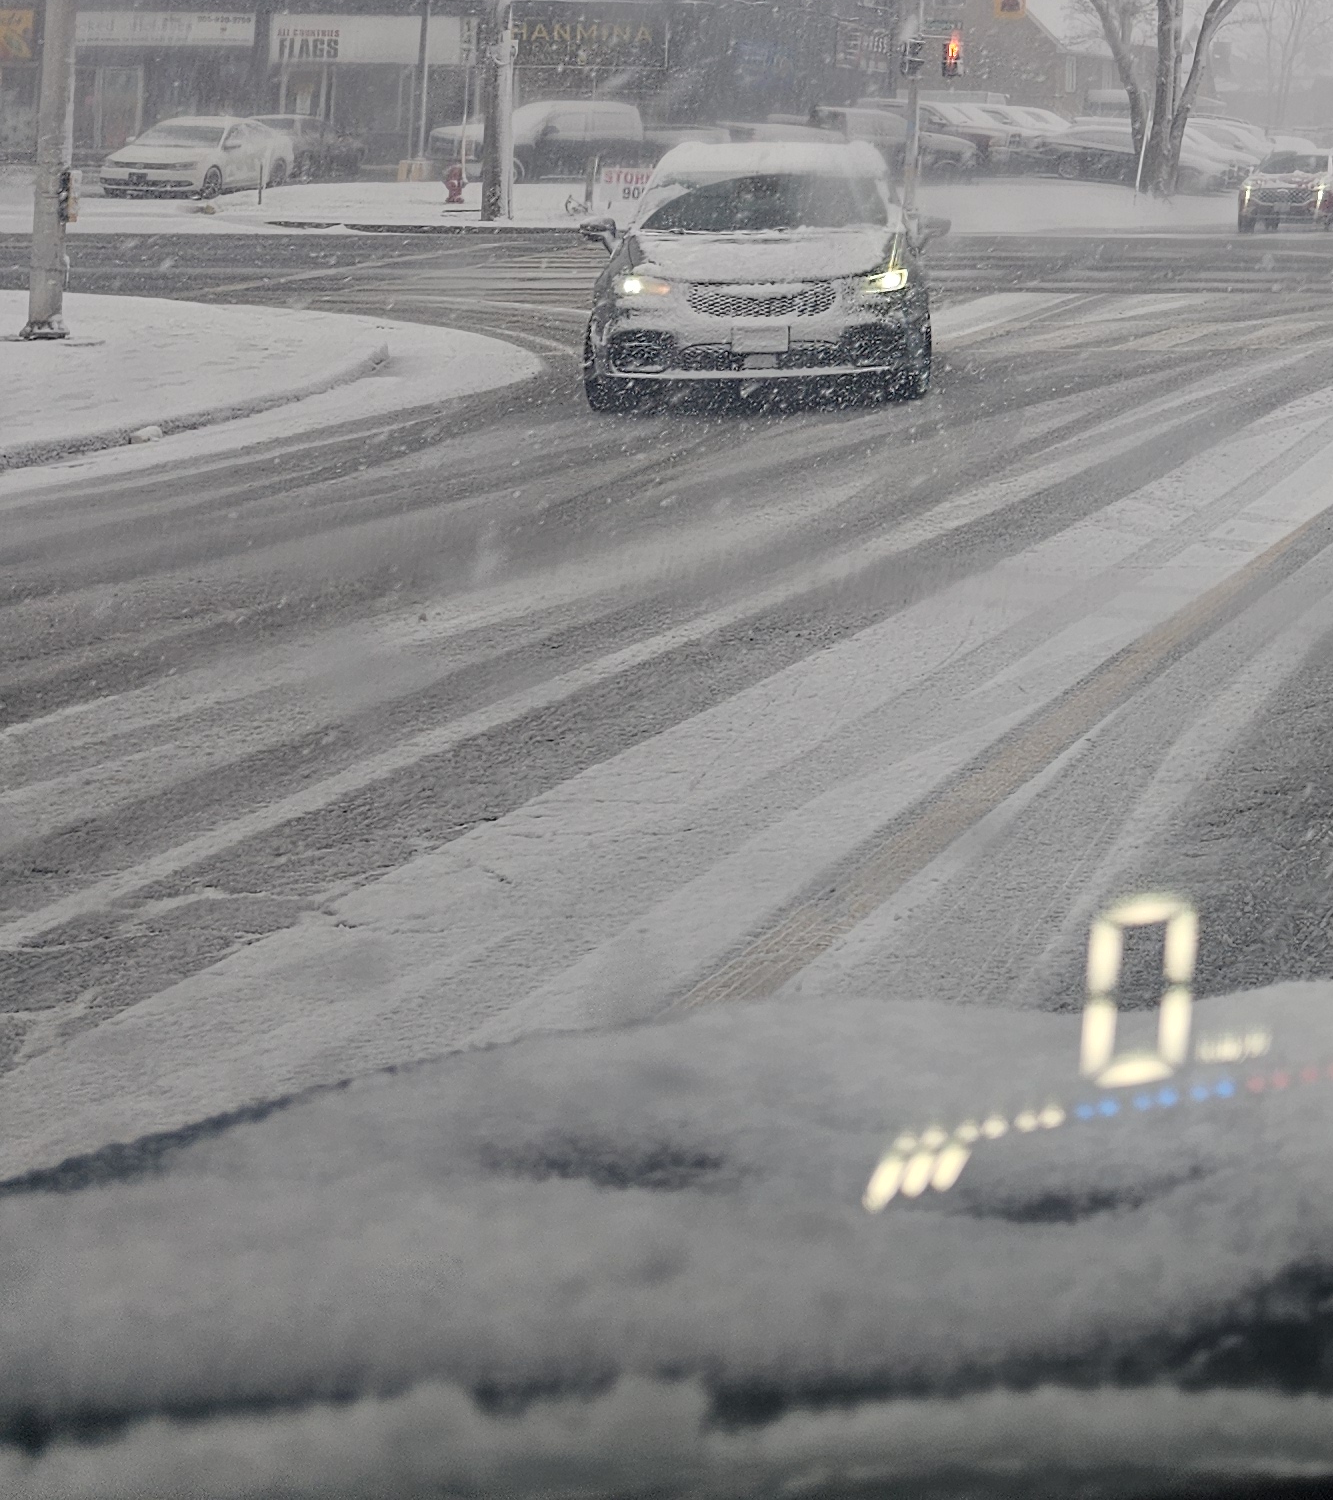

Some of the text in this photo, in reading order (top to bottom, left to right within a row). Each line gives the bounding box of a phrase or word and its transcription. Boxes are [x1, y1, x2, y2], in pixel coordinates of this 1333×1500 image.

[511, 22, 653, 43] HANMINA
[278, 38, 339, 60] FLAGS
[622, 187, 645, 199] 90
[1079, 893, 1199, 1087] 0
